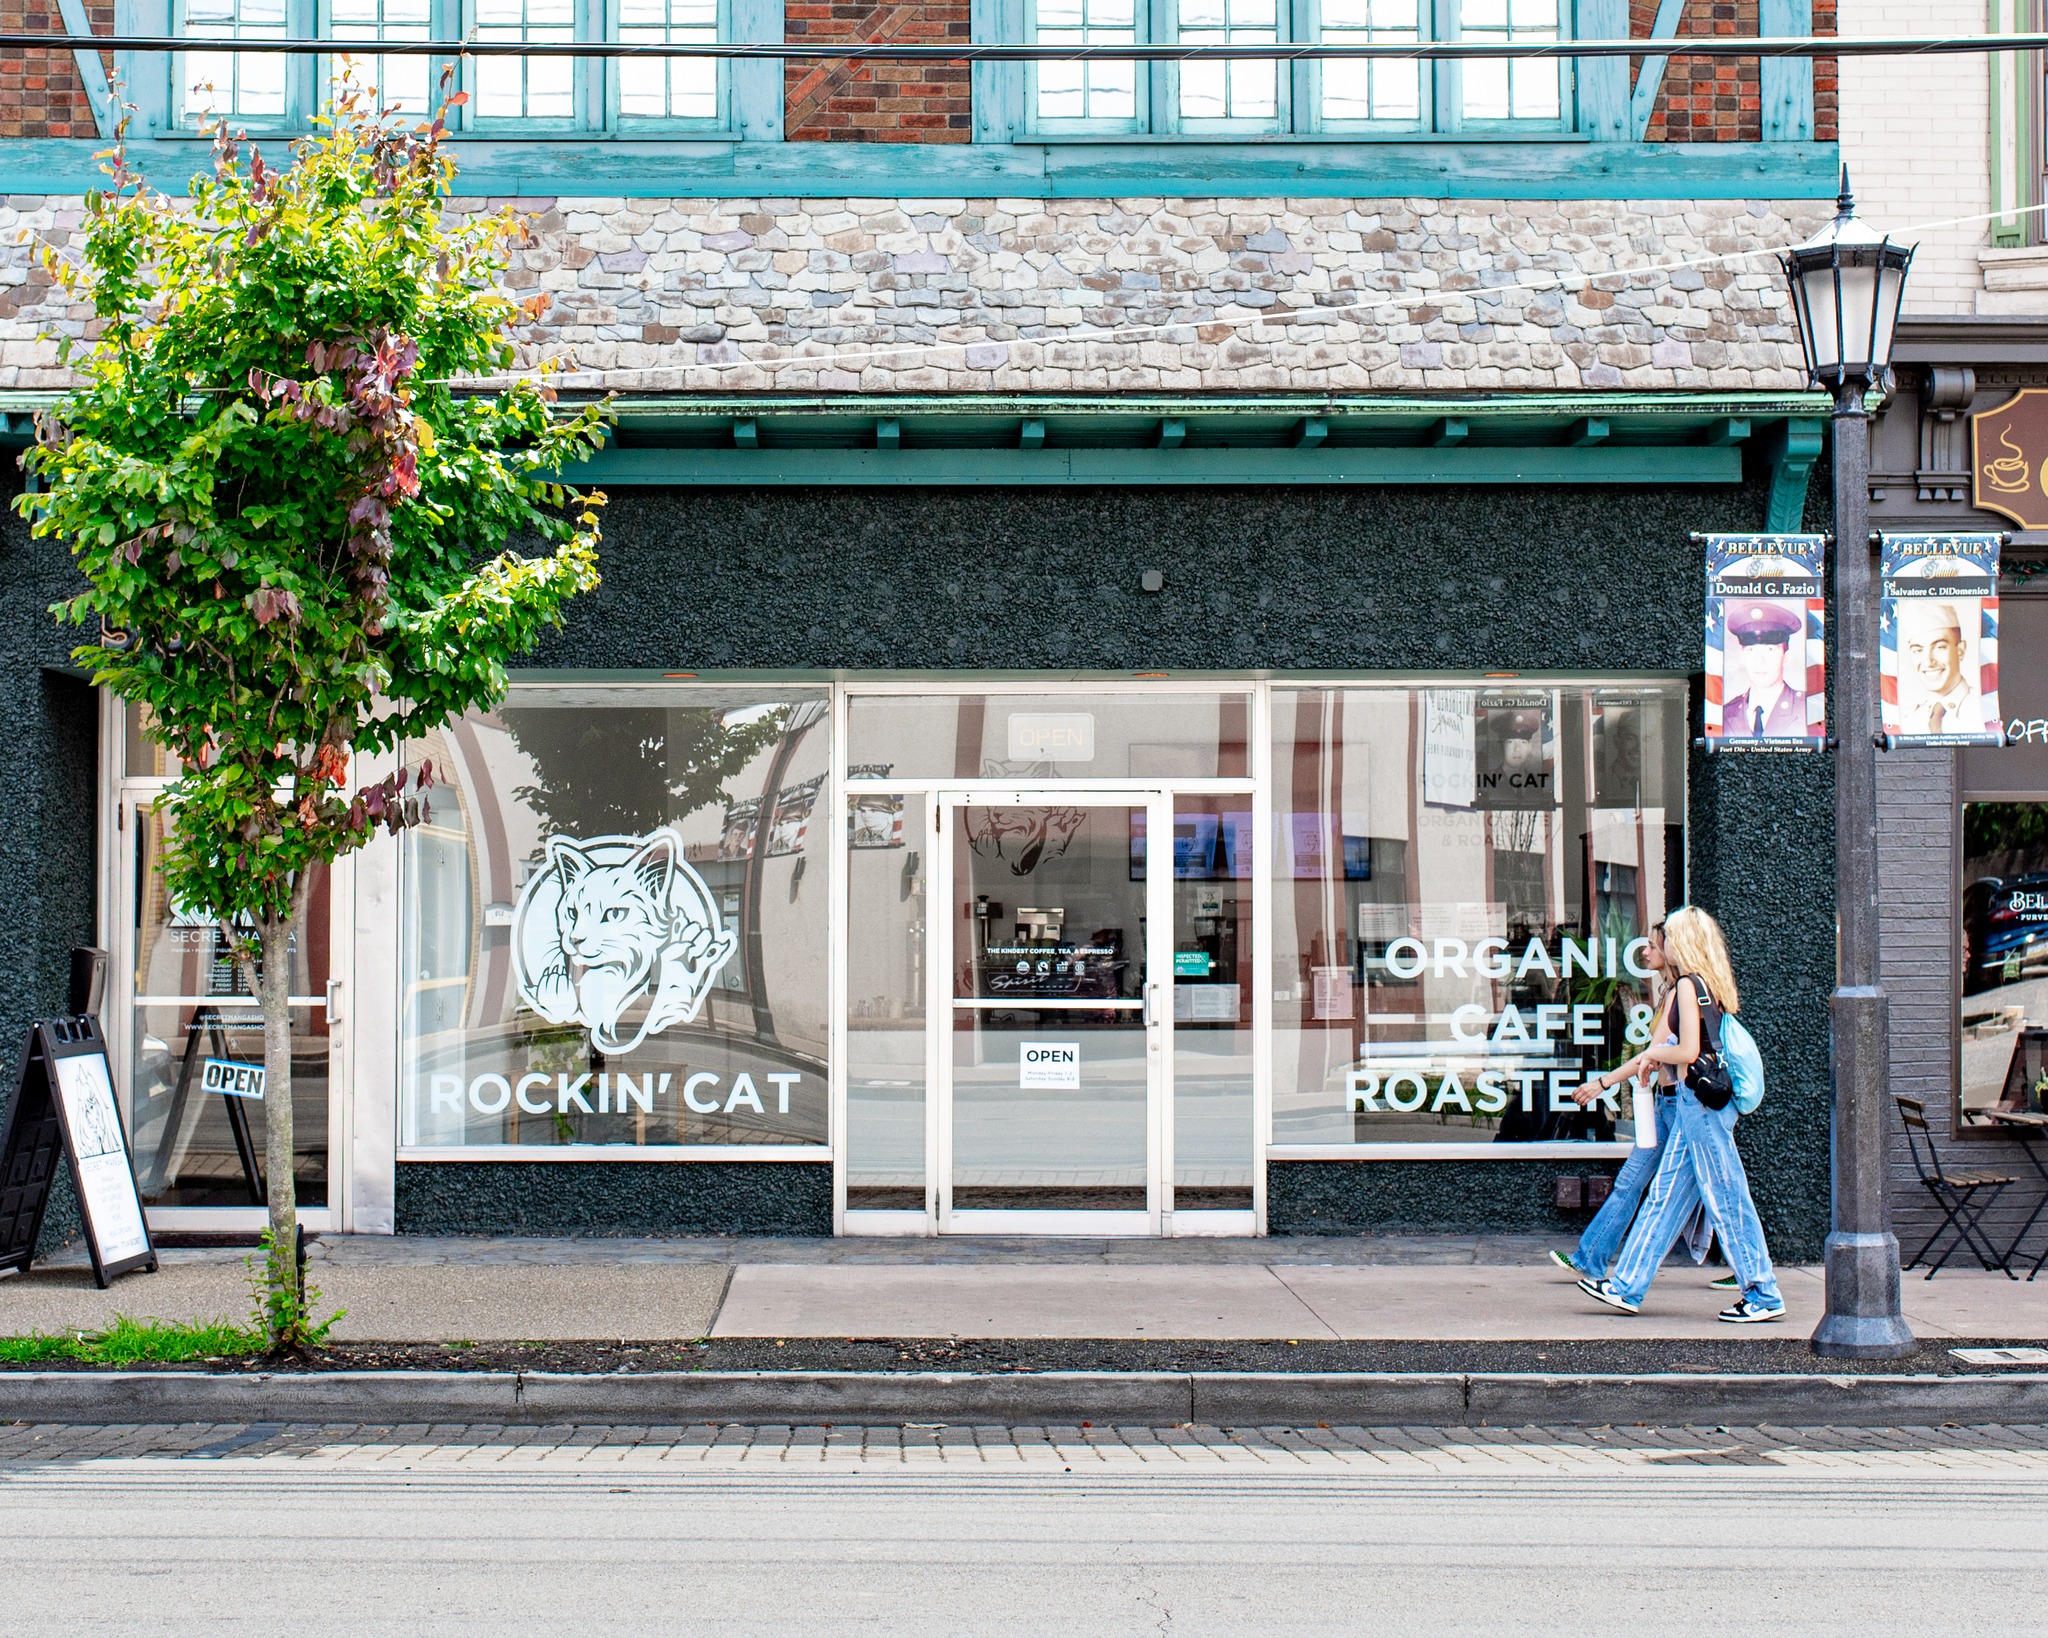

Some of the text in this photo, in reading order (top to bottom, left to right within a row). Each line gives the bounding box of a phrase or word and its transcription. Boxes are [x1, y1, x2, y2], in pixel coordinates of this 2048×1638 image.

[1728, 542, 1807, 555] BELLEVUE
[1903, 542, 1982, 555] BELLEVUE
[1716, 582, 1815, 595] Donald G. Fazio
[1883, 581, 1896, 590] Cpl
[1890, 587, 1989, 596] Salvatore C. DiDomenico
[1020, 728, 1083, 746] OPEN
[1729, 738, 1758, 746] Germany
[1509, 773, 1550, 788] CAT
[170, 930, 297, 943] SECRE MAA
[1030, 947, 1057, 955] COFFEE,
[1058, 947, 1074, 956] TEA,
[1080, 947, 1114, 955] ESPRESSO
[1384, 936, 1660, 979] ORGANIC
[991, 974, 1049, 989] Spirit
[1450, 1003, 1654, 1045] CAFE &
[1026, 1049, 1074, 1063] OPEN
[205, 1064, 264, 1094] OPEN
[430, 1073, 801, 1114] ROCKIN' CAT
